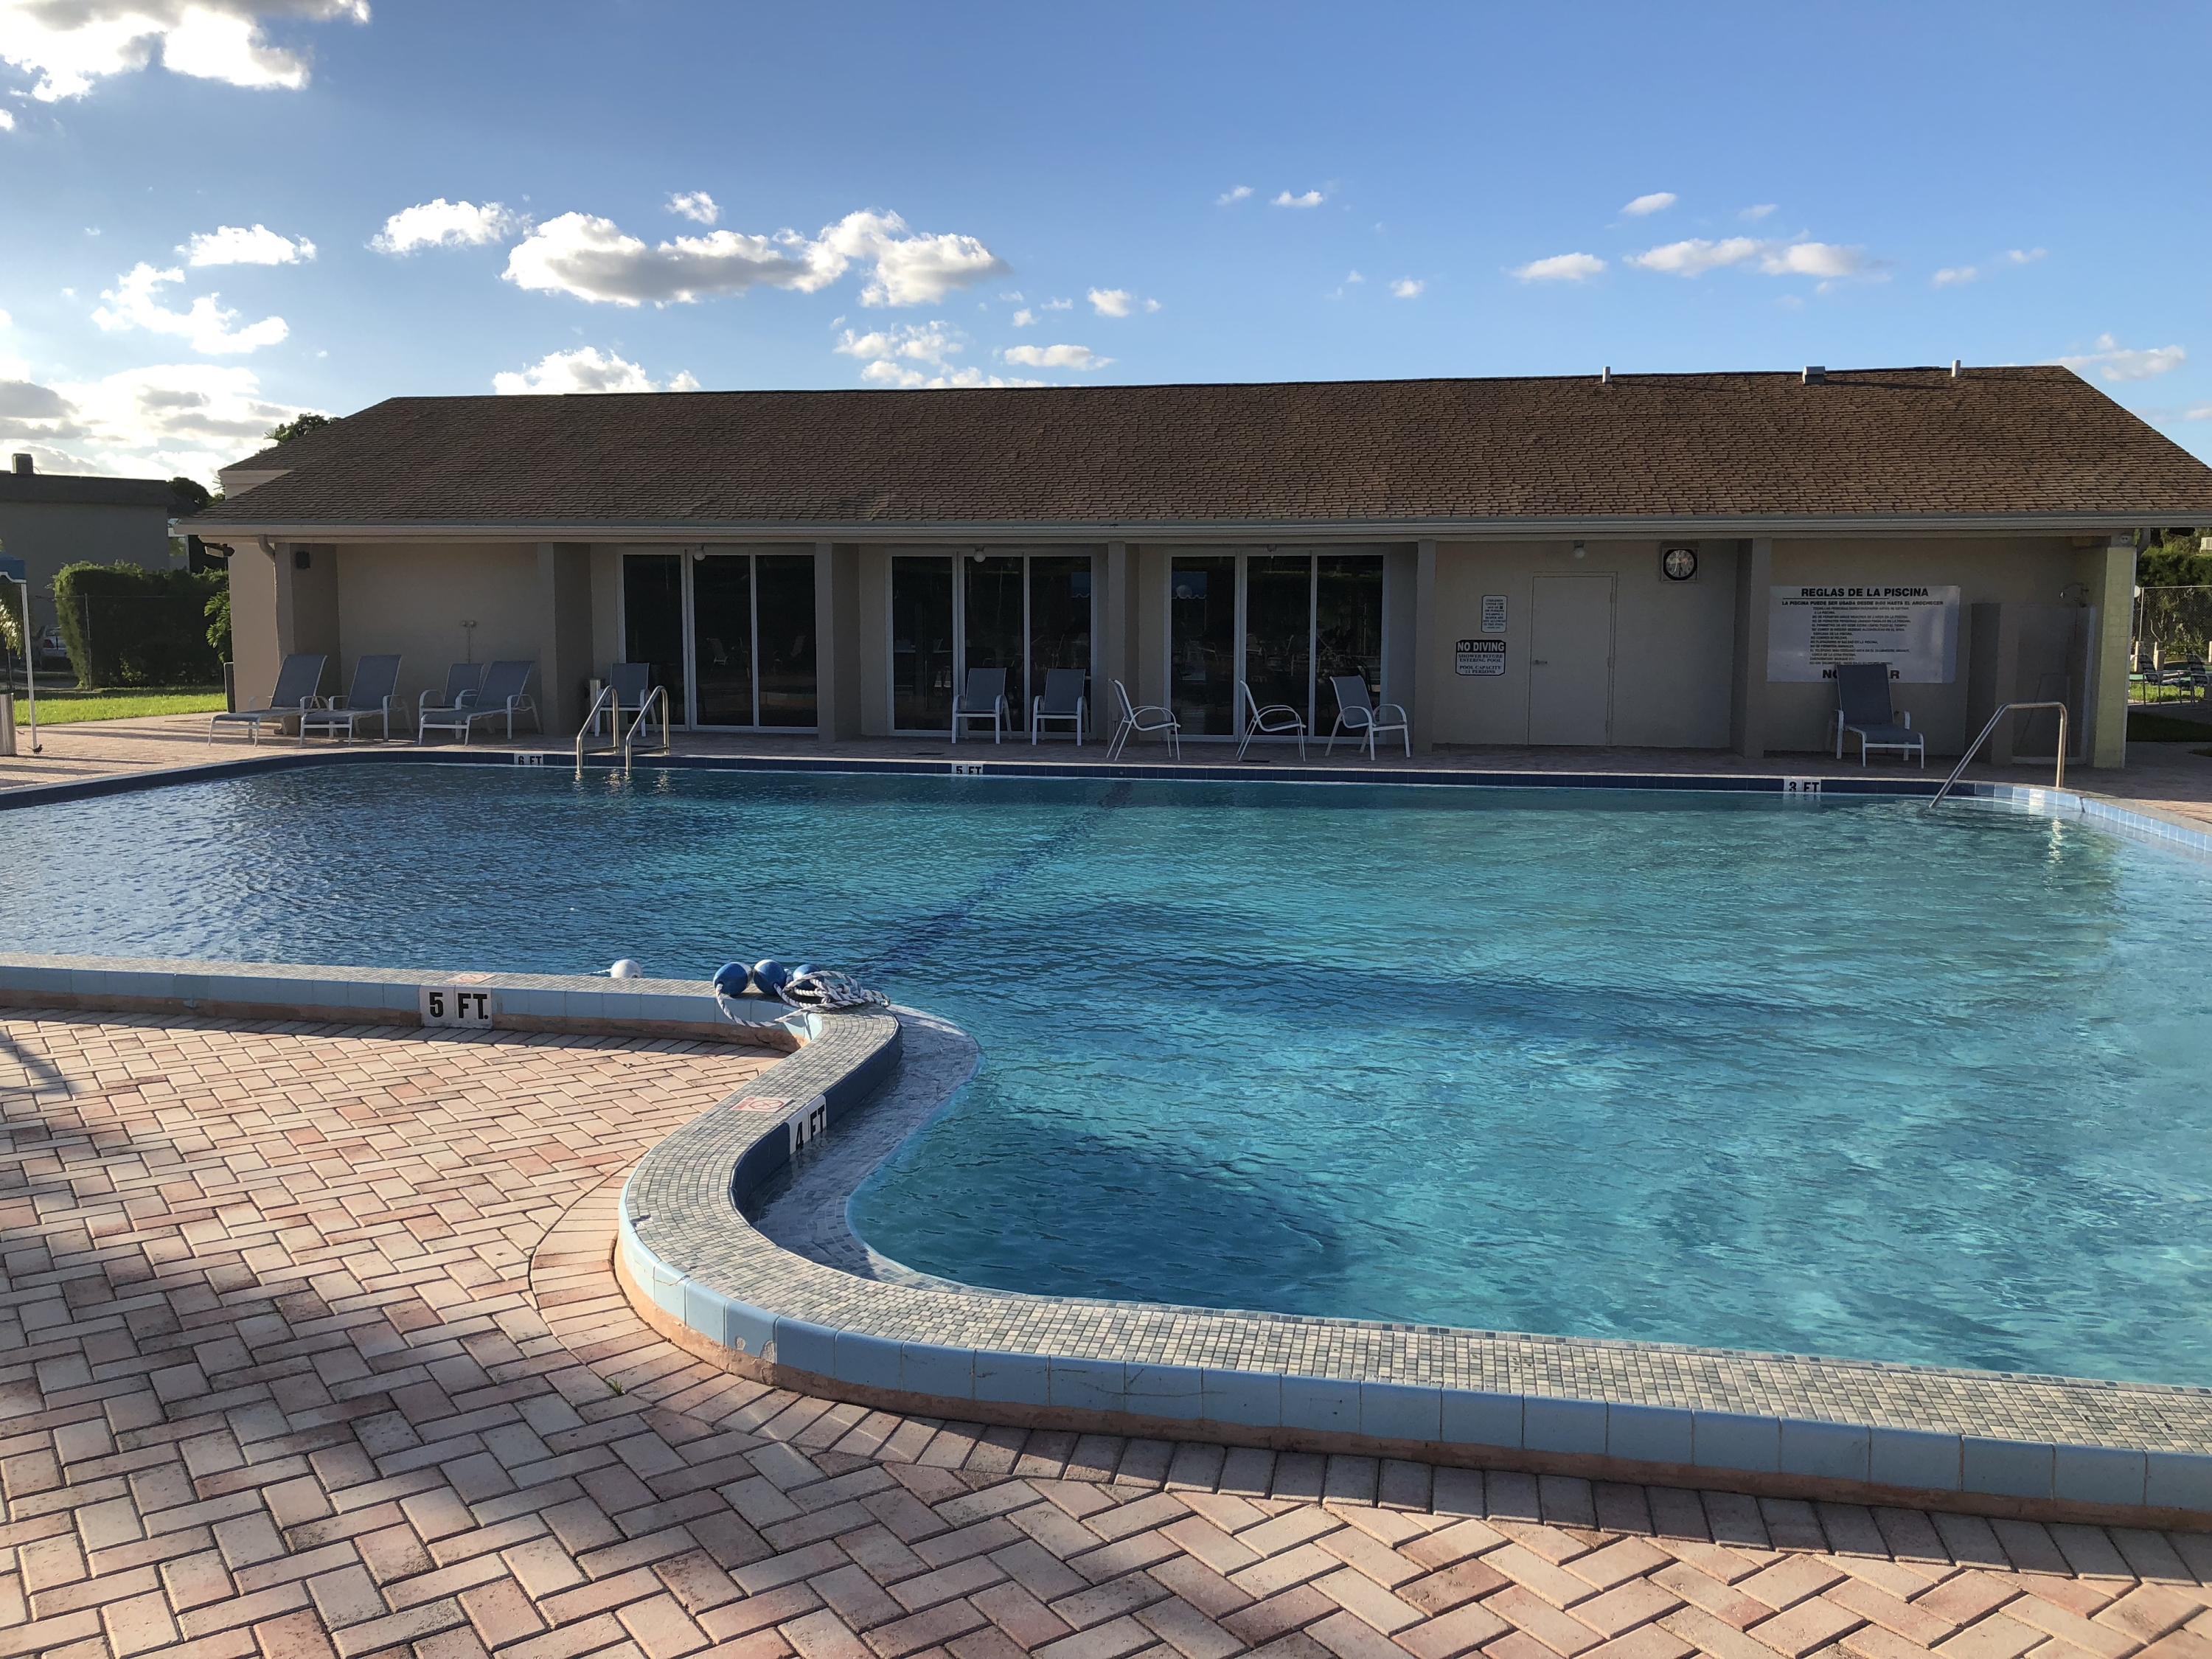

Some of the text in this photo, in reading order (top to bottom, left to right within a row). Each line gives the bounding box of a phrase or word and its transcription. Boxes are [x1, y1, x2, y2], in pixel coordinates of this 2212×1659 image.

[1801, 588, 1929, 597] REGLAS DE LA PISCINA
[1457, 642, 1504, 651] NO DIVING
[518, 755, 542, 765] 6 FT
[956, 765, 981, 775] 5 FT
[1789, 782, 1820, 793] 3 FT
[429, 992, 489, 1020] 5 FT.
[796, 1104, 825, 1150] 4 FT
